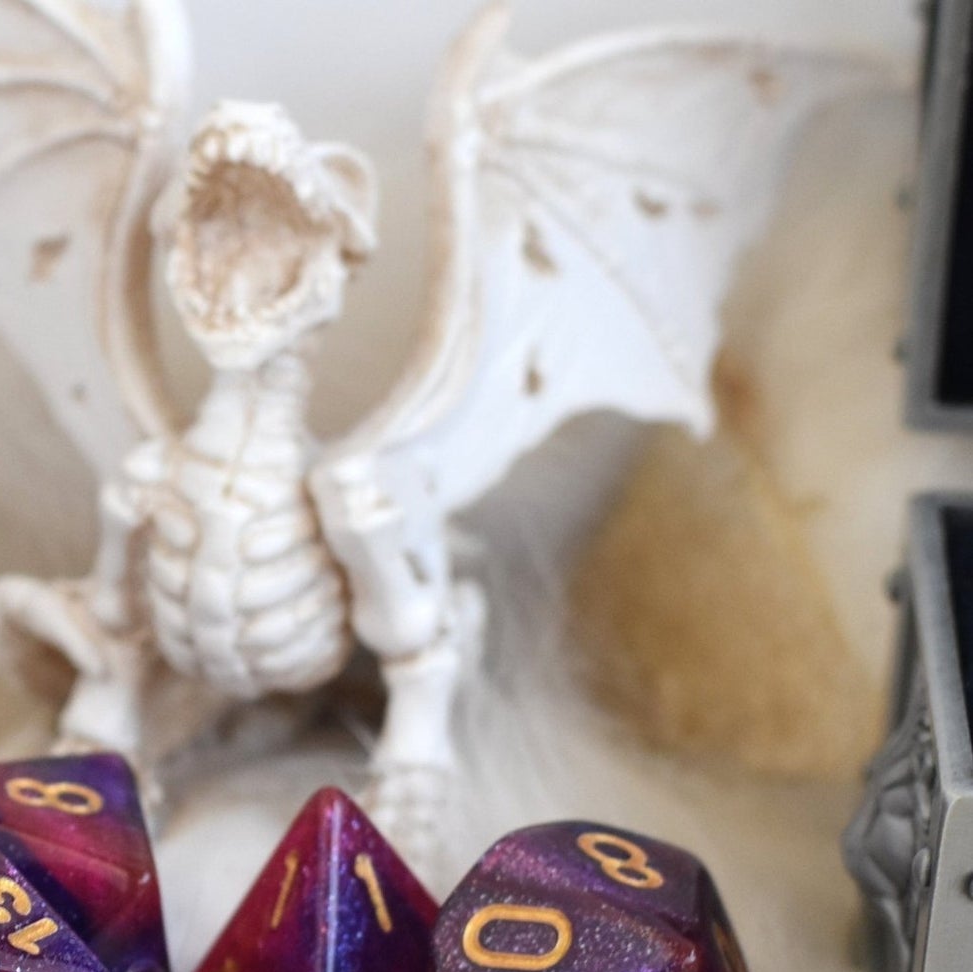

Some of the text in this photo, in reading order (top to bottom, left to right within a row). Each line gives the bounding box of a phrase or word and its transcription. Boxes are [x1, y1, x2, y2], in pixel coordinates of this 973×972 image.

[5, 776, 104, 816] 8
[577, 832, 664, 889] 8
[462, 903, 573, 972] 0
